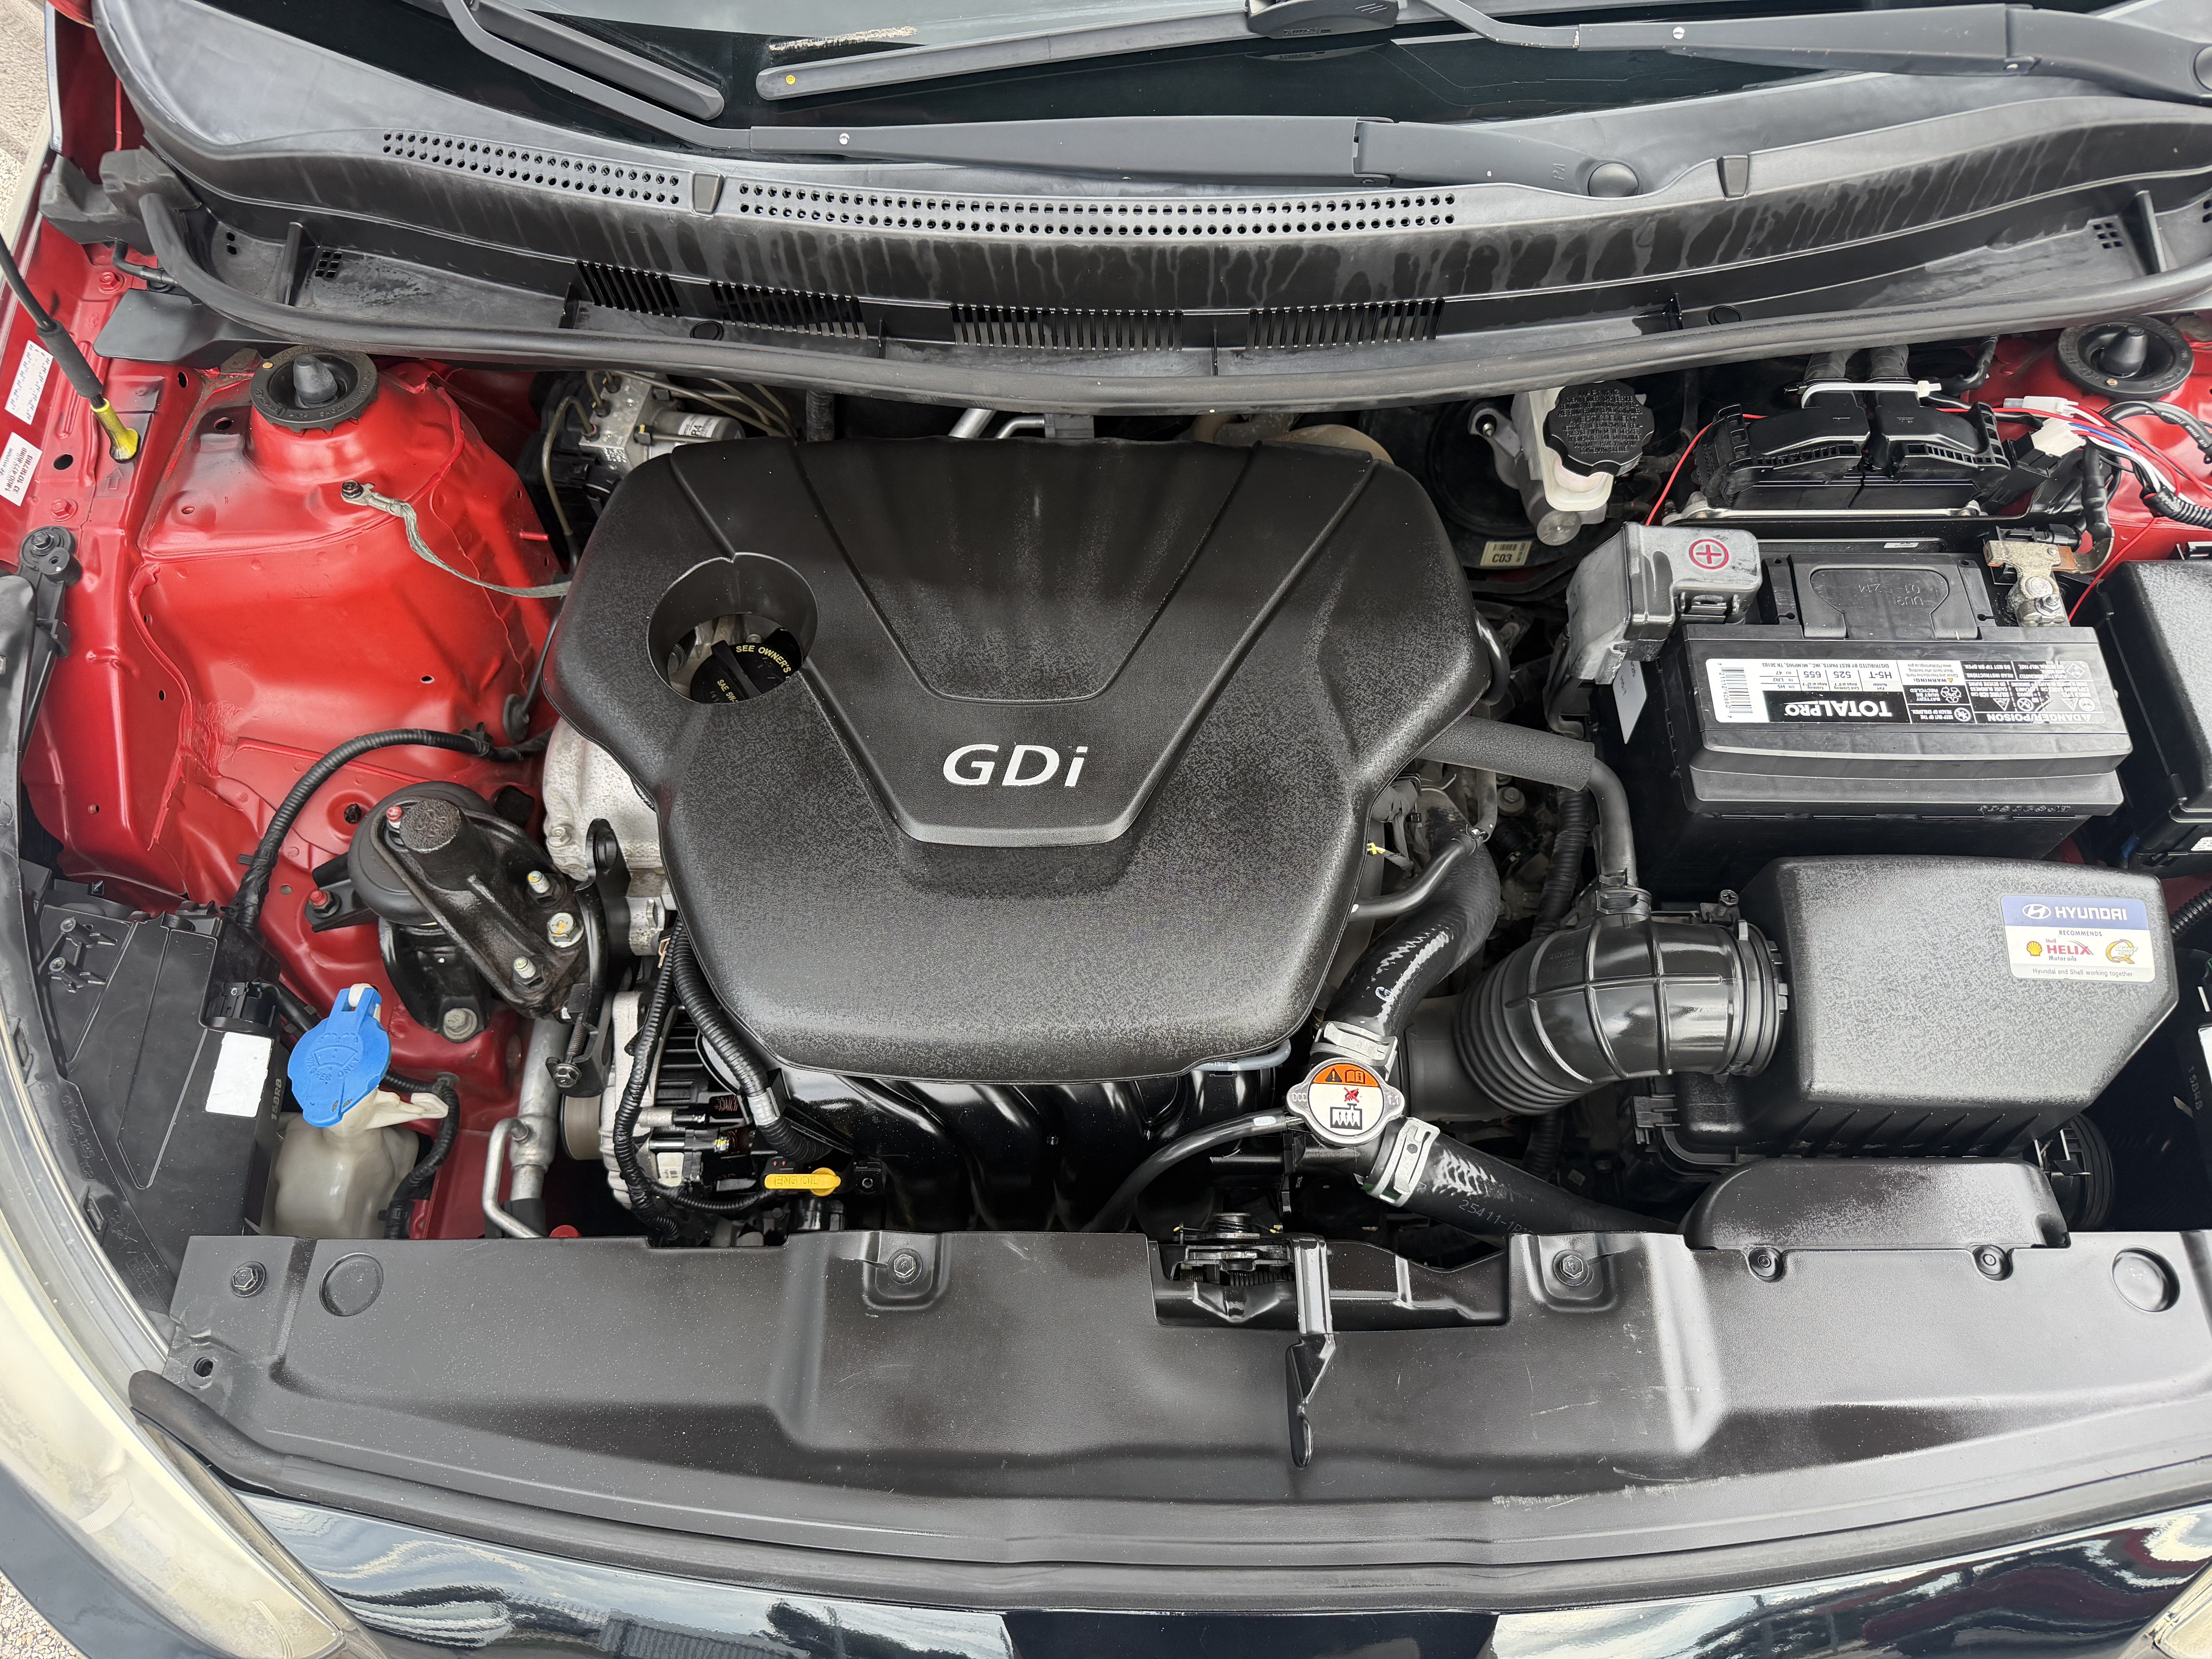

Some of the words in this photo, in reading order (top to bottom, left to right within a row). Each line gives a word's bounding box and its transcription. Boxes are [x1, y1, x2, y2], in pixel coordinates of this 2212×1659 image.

[1492, 554, 1512, 563] C03
[758, 647, 792, 673] OWNER'S
[717, 679, 730, 692] SAE
[726, 692, 739, 702] 5W-
[1986, 713, 2082, 721] DANGER/POISON
[942, 744, 1088, 788] GDi
[2055, 906, 2128, 921] HYUNDAI
[2046, 945, 2092, 955] HELIX
[338, 1057, 359, 1077] ONLY
[775, 1176, 797, 1186] ENG
[801, 1176, 818, 1186] OIL
